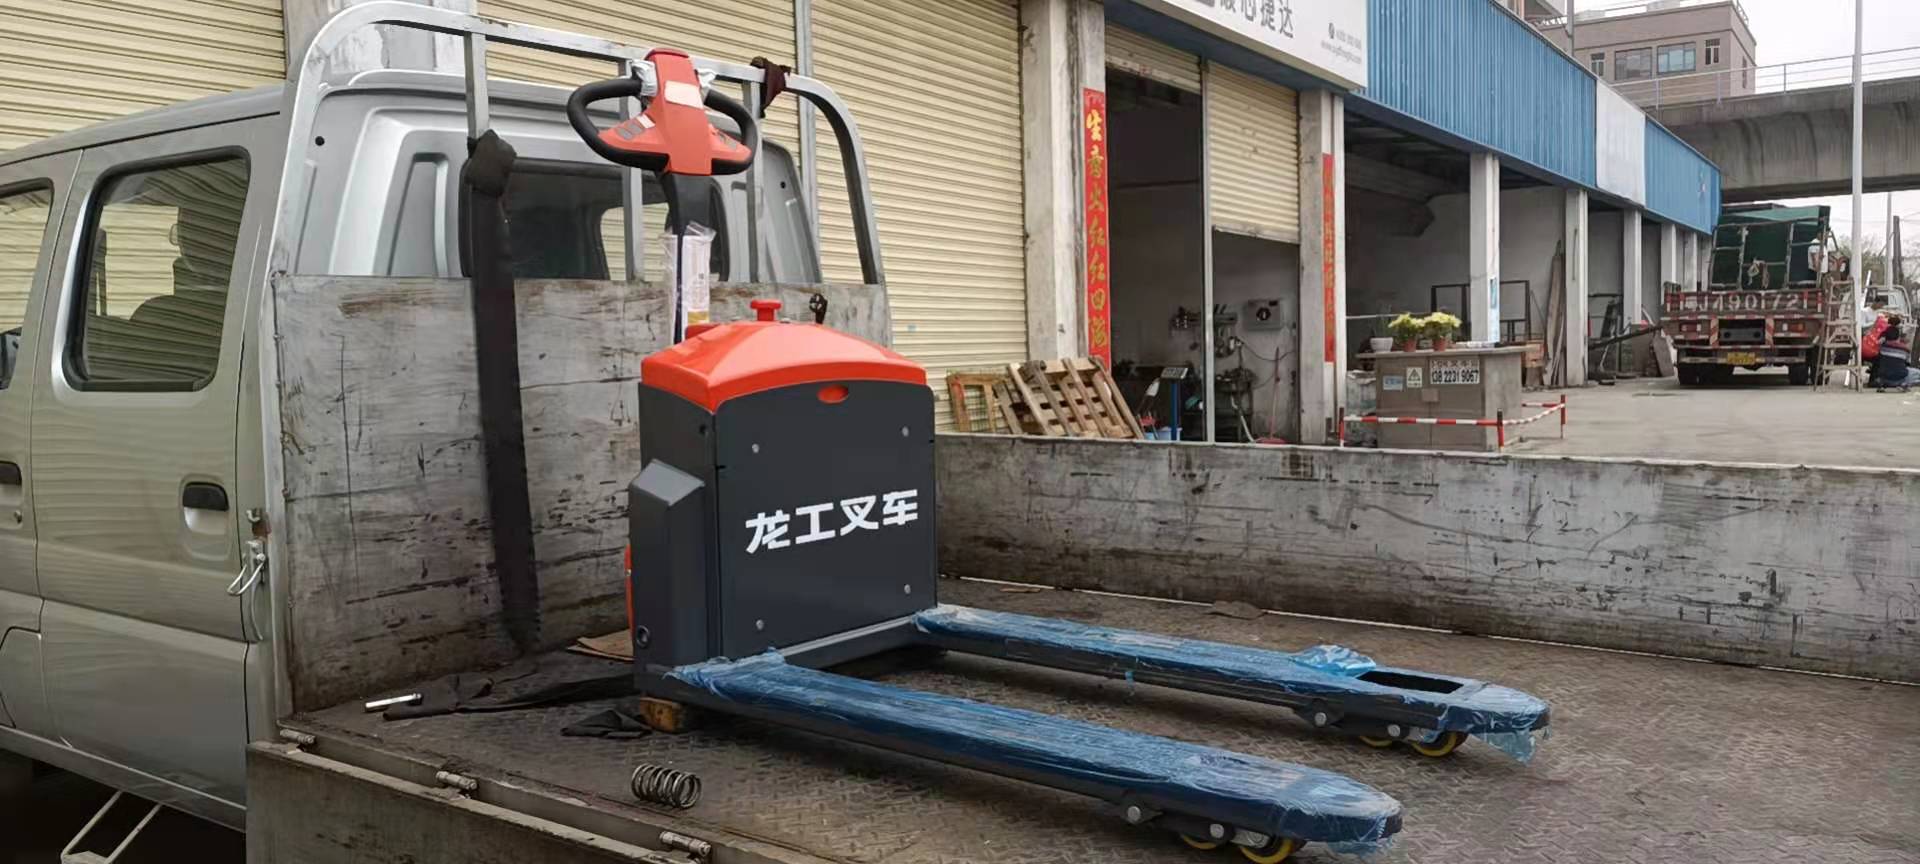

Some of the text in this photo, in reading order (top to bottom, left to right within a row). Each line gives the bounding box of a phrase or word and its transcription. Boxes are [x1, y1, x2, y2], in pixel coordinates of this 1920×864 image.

[1220, 0, 1293, 38] 心捷达
[745, 489, 918, 554] 龙工叉车
